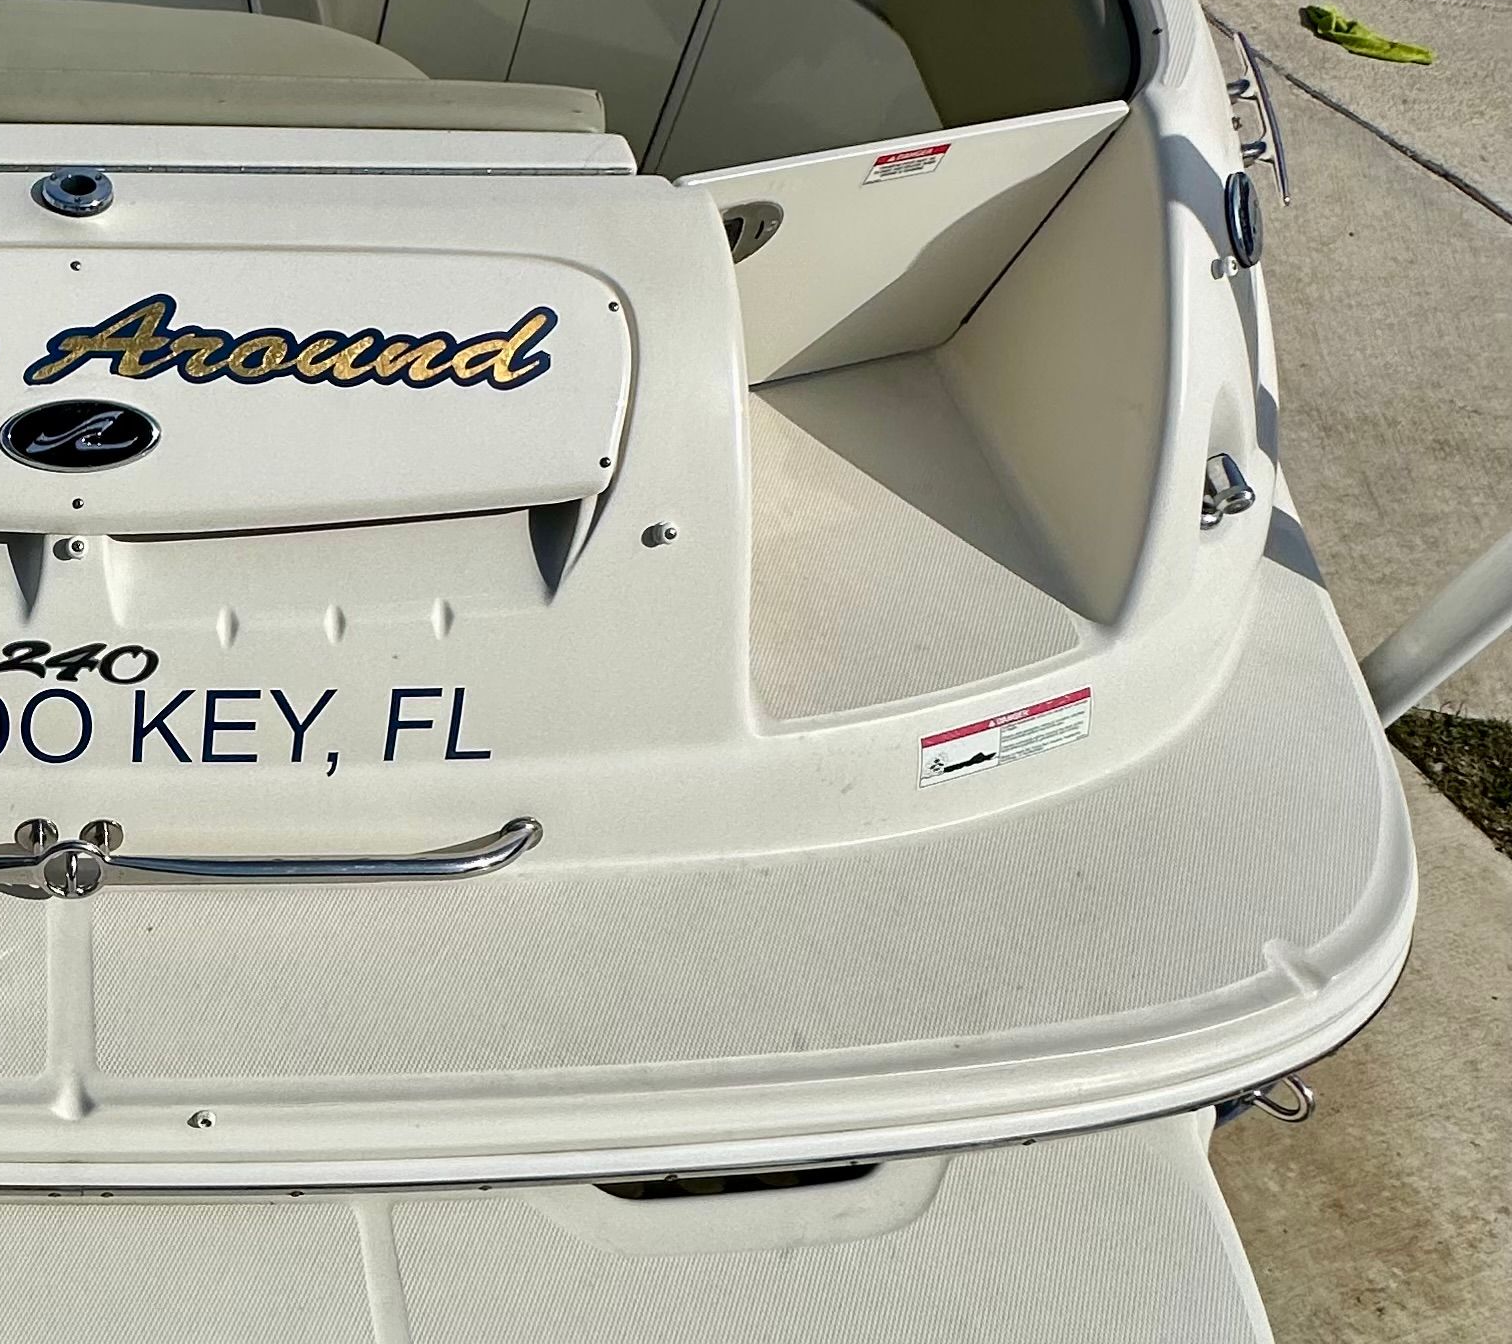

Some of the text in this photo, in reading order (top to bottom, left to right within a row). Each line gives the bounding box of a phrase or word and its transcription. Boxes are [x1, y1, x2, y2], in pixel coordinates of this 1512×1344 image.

[23, 294, 558, 390] Around
[131, 687, 339, 777] KEY,
[384, 688, 491, 761] FL
